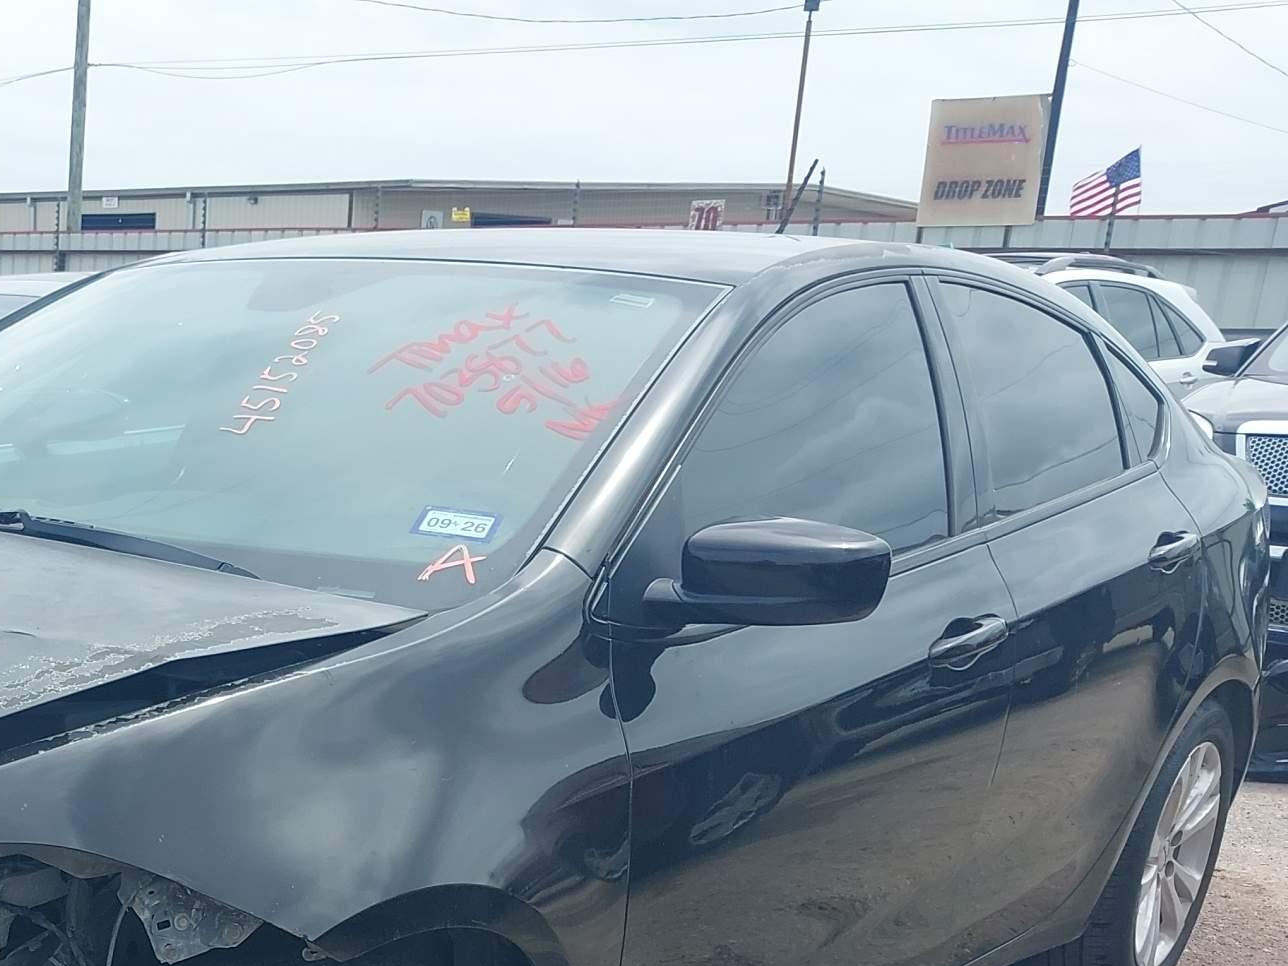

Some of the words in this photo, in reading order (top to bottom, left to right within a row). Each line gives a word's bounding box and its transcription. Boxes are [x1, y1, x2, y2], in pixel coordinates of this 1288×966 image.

[934, 180, 982, 200] DROP
[981, 179, 1027, 199] ZONE
[219, 310, 340, 435] 45152085
[427, 517, 452, 529] 09
[460, 521, 488, 533] 26
[417, 544, 487, 585] A
